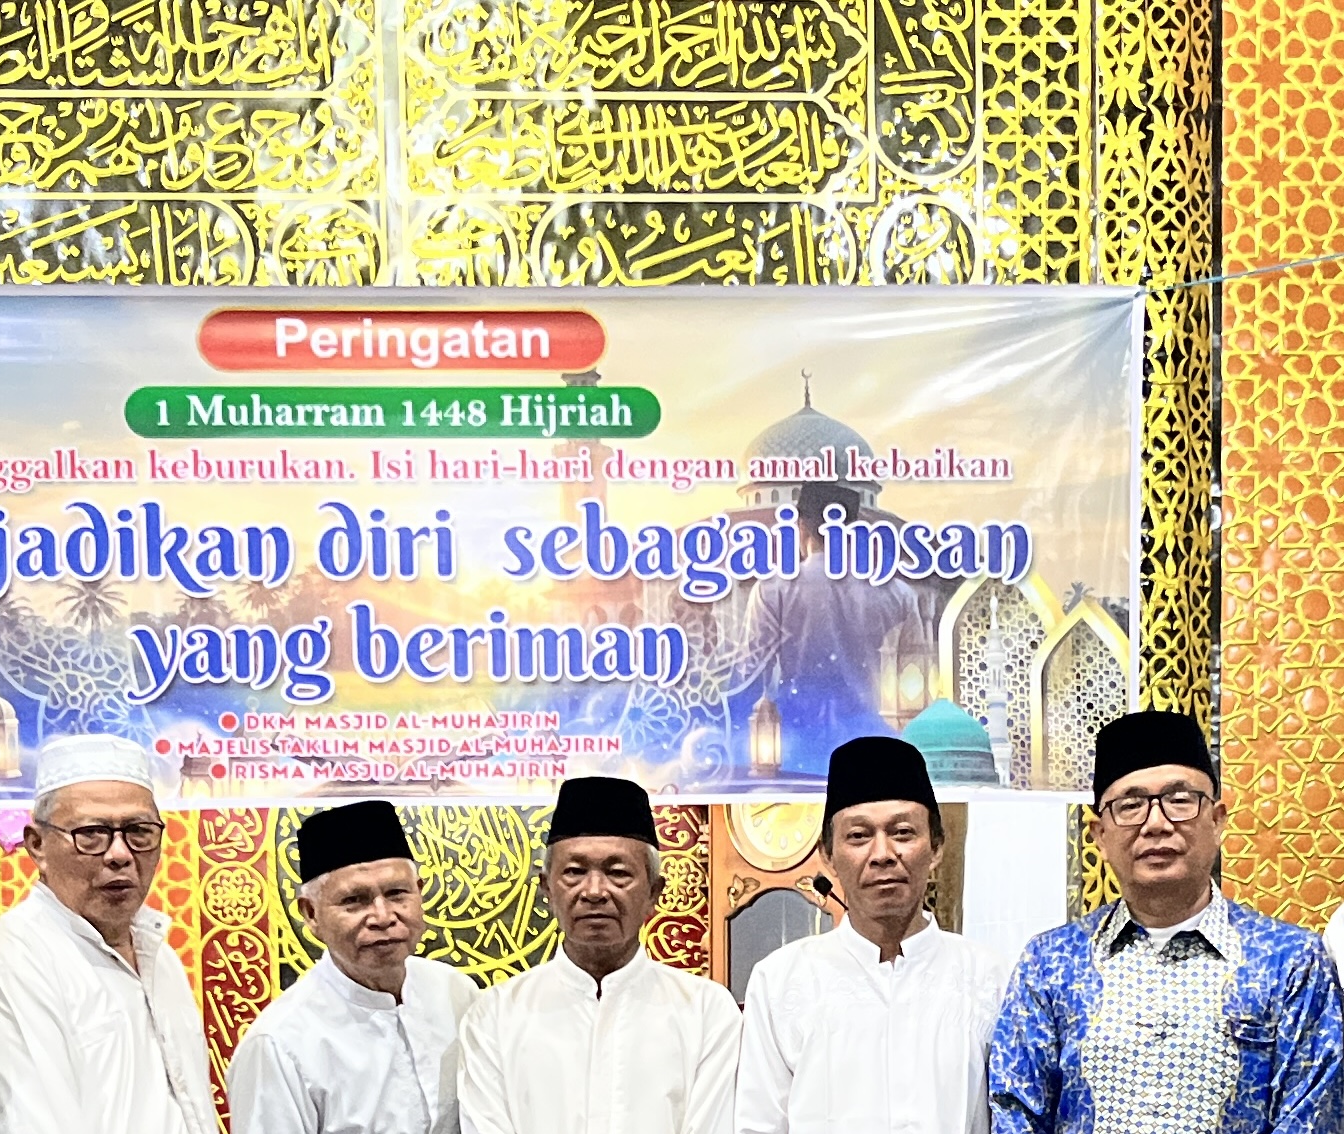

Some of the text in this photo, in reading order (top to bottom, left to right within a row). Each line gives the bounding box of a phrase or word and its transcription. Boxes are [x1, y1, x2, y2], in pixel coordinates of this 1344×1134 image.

[275, 317, 551, 368] Peringatan
[156, 394, 633, 437] 1 Muharram 1448 Hijriah
[150, 449, 354, 480] keburukan.
[371, 449, 417, 480] Isi
[430, 449, 592, 480] hari-hari
[605, 449, 736, 491] dengan
[750, 448, 837, 480] amal
[847, 448, 1011, 480] kebaikan
[319, 502, 453, 579] diri
[503, 502, 795, 598] sebagai
[826, 507, 1032, 583] insan
[129, 604, 686, 701] yang beriman
[245, 713, 558, 731] DKM MASJID AL-MUHAJIRIN
[178, 737, 620, 755] MAJELIS TAKLIM MASJID AL-MUHAJIRIN
[235, 762, 565, 780] RISMA MASJID AL-MUHAJIRIN
